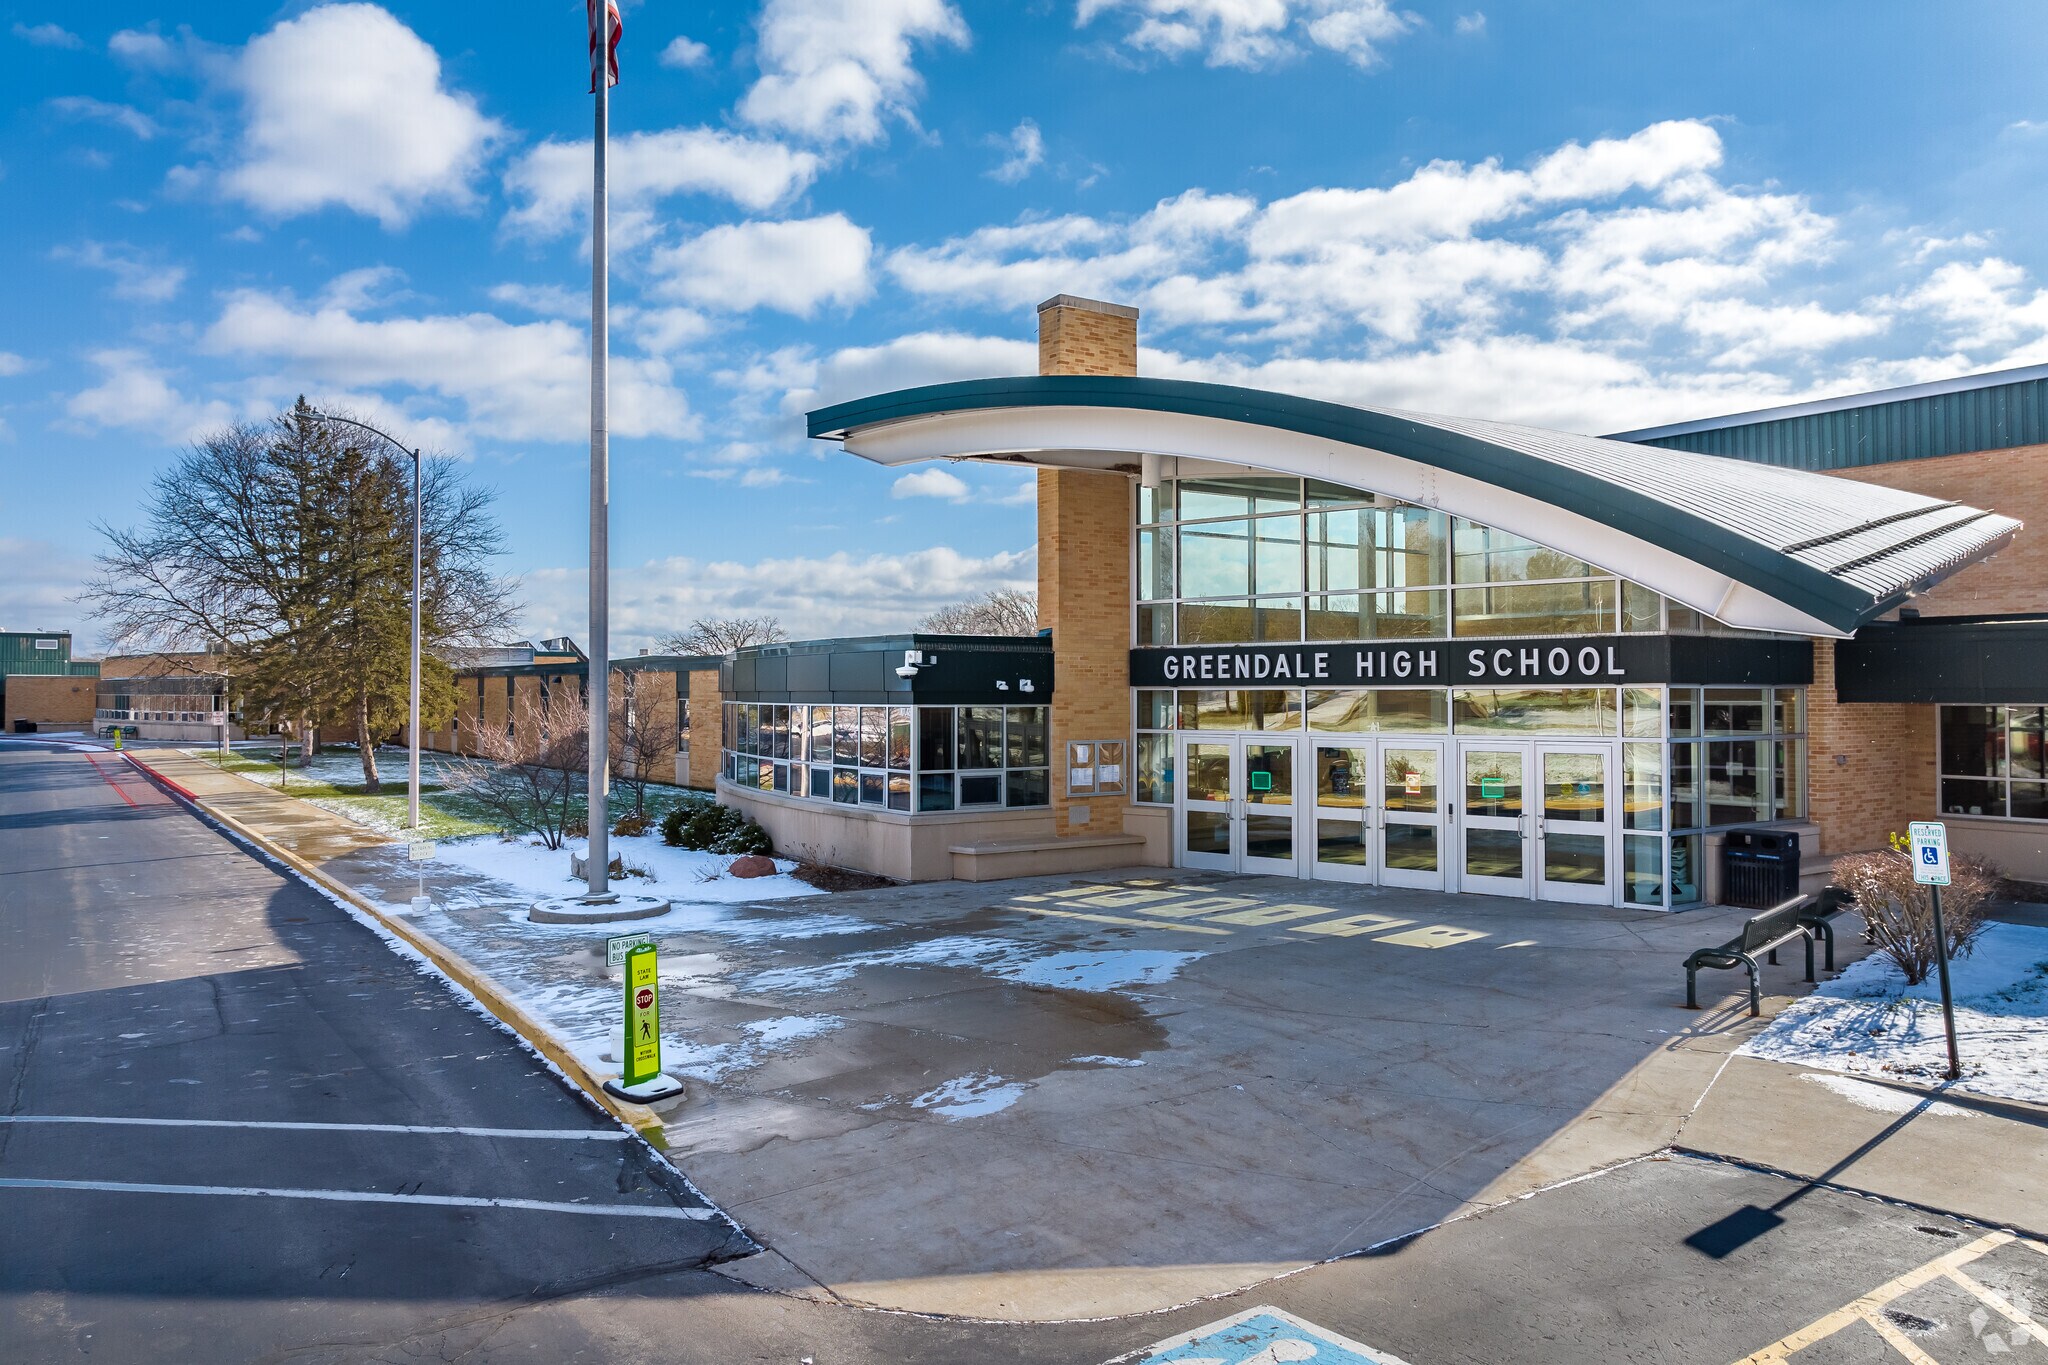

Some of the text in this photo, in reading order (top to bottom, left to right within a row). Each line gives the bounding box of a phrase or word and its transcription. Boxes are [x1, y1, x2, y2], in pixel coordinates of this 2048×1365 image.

[1163, 646, 1625, 680] GREENDALE HIGH SCHOOL
[1913, 828, 1942, 837] RESERVED
[1917, 838, 1941, 847] PARKING
[611, 941, 621, 951] NO
[612, 951, 624, 962] BUS
[637, 968, 651, 976] STATE
[636, 994, 653, 1005] STOP
[640, 1010, 650, 1018] FOR
[636, 1053, 656, 1062] CROSSWALK
